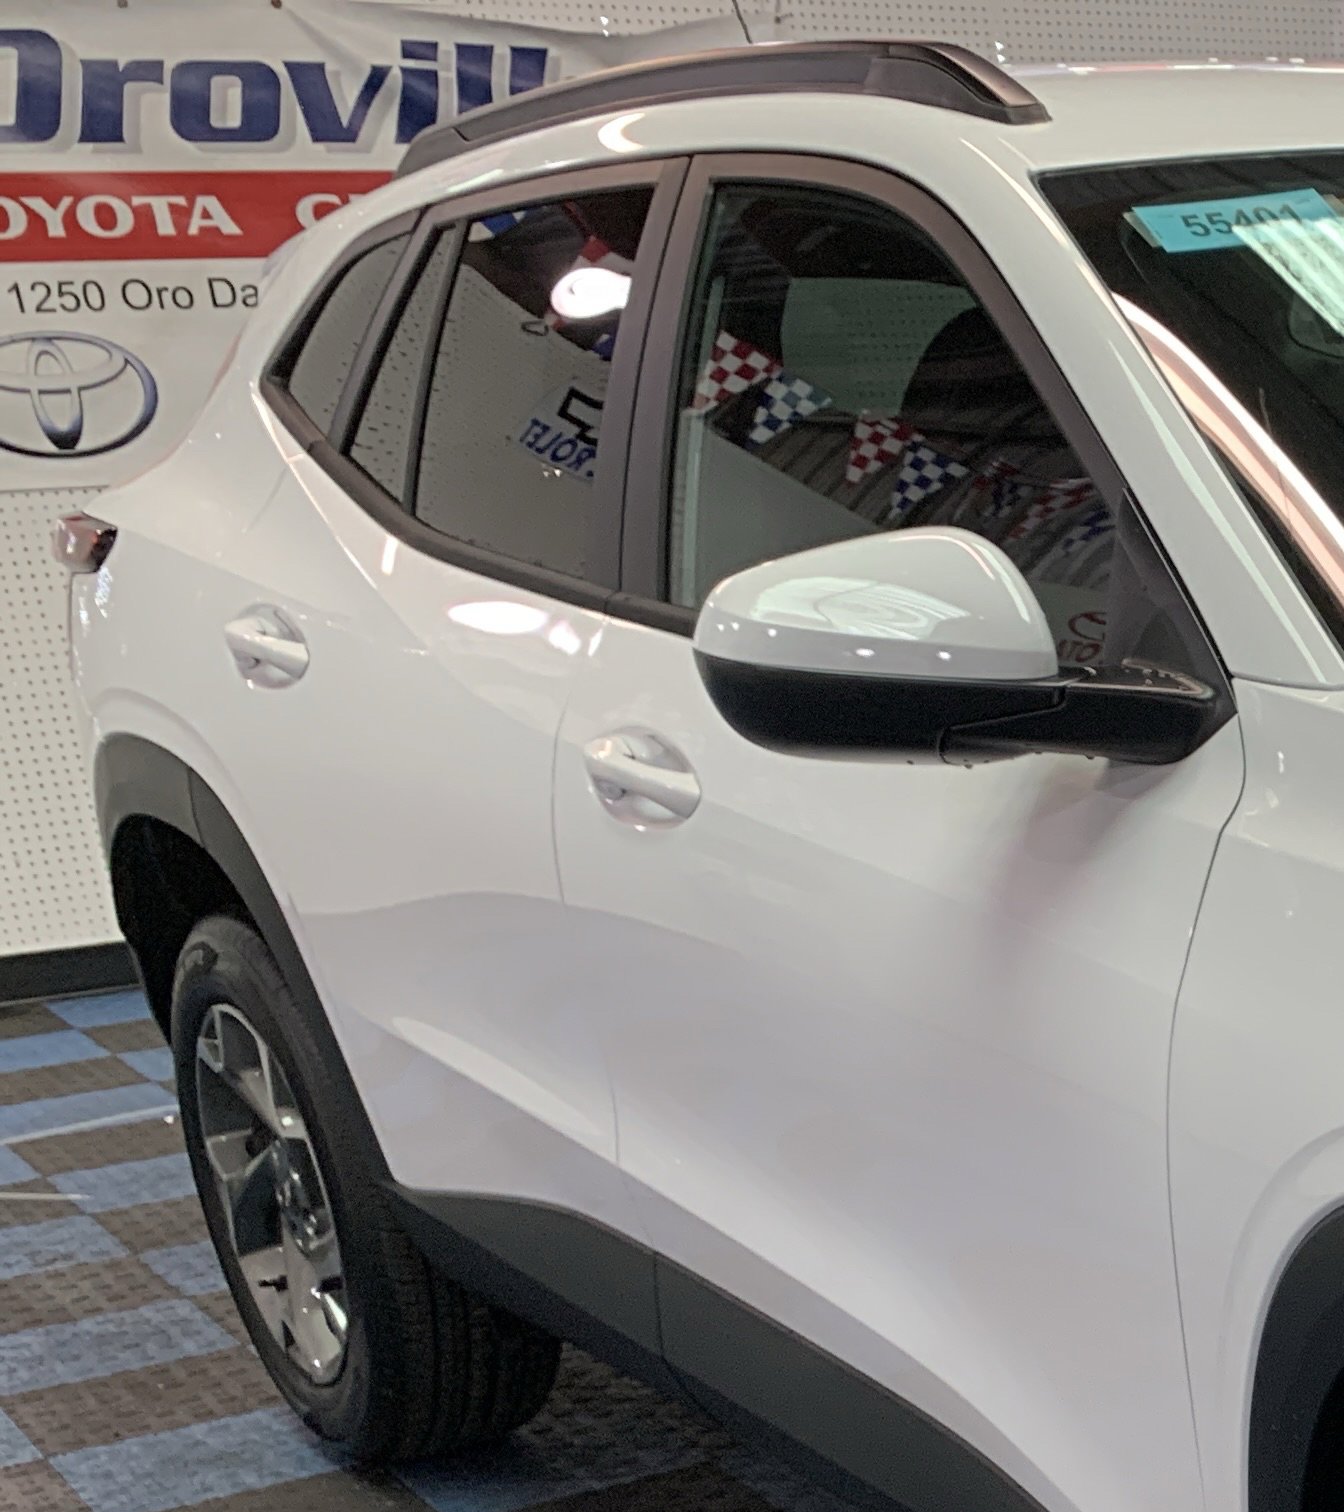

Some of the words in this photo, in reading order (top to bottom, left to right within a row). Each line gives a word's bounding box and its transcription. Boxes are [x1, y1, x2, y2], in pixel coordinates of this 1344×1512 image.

[0, 29, 548, 143] Orovil
[0, 194, 244, 241] YOTA
[7, 279, 106, 314] 1250
[121, 278, 194, 311] Oro
[207, 277, 259, 309] Da
